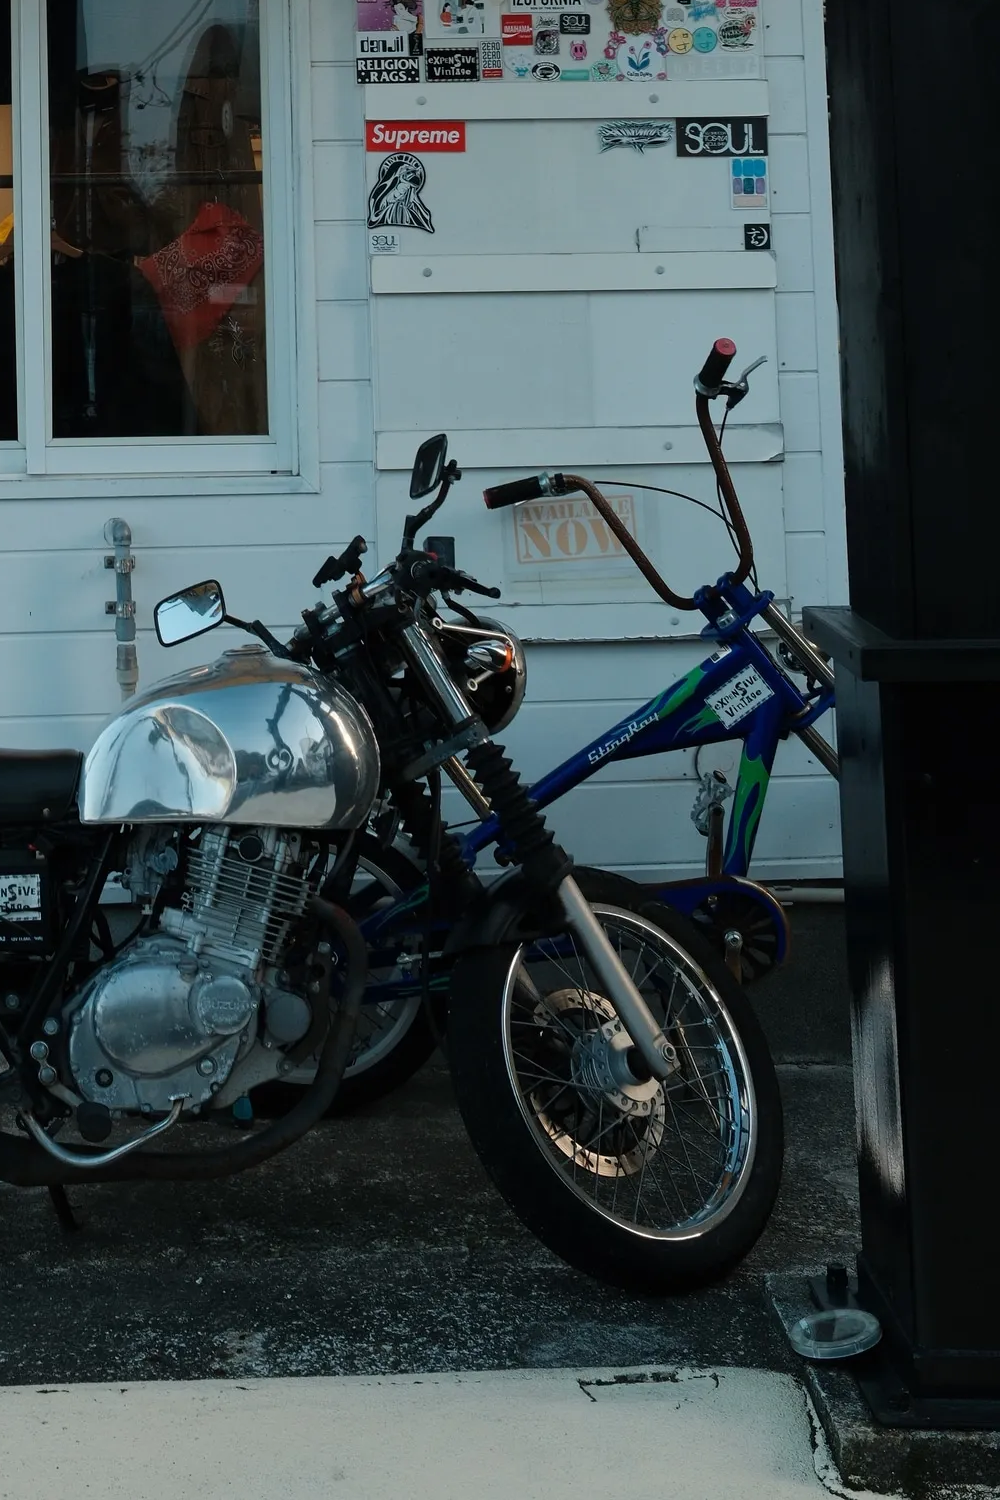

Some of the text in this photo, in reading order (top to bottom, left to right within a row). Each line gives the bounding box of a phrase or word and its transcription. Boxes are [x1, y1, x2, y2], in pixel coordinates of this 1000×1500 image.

[562, 15, 589, 26] SOUL
[481, 42, 500, 51] ZERO
[482, 51, 501, 60] ZERO
[357, 59, 419, 71] RELIGION
[482, 60, 502, 69] ZERO
[369, 71, 408, 82] RAGS
[371, 123, 460, 150] Supreme
[684, 122, 764, 155] SOUL
[371, 235, 399, 246] SOUL
[519, 517, 630, 559] NOW
